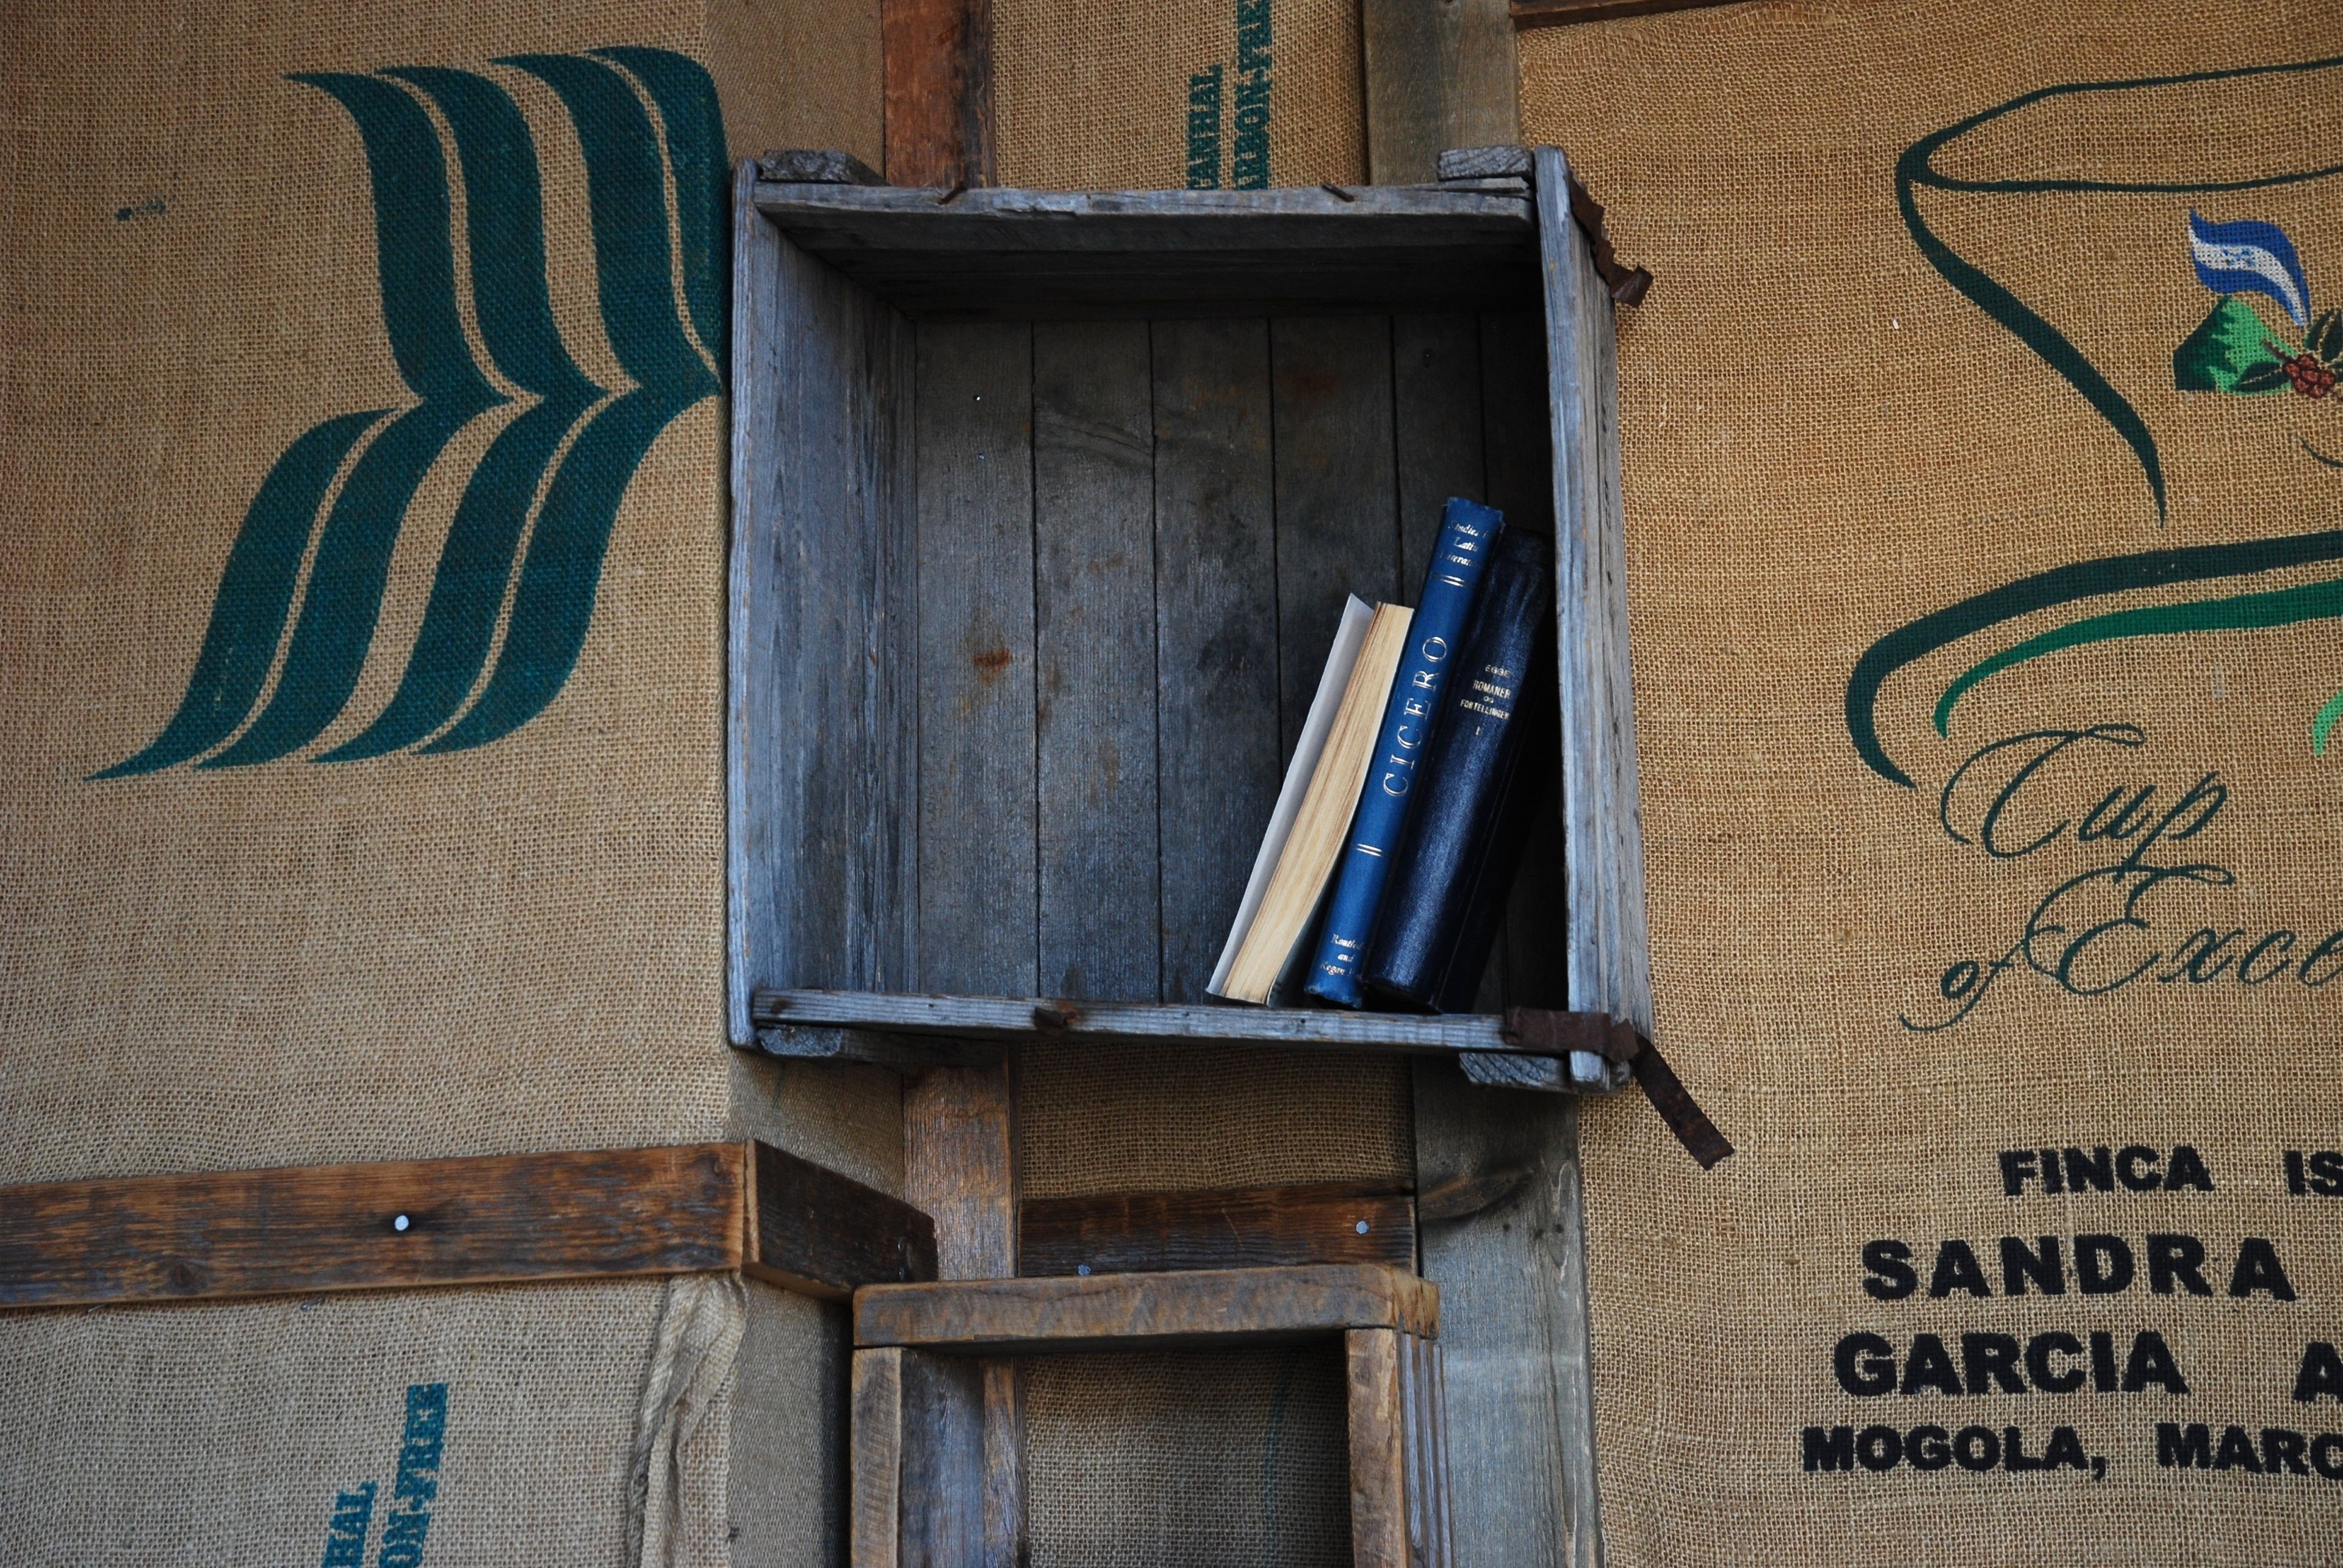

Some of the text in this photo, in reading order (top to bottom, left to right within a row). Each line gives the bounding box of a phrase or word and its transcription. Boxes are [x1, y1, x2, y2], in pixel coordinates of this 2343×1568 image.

[1454, 537, 1478, 552] Latin
[1472, 680, 1510, 699] ROMANER
[1485, 664, 1510, 678] EGGE
[1383, 636, 1447, 796] CICERO
[1460, 699, 1510, 719] FORTELLINGER
[1940, 723, 2230, 883] Cup
[1337, 954, 1355, 962] and
[1899, 922, 2065, 1032] of
[1998, 1146, 2214, 1196] FINCA
[1862, 1234, 2297, 1302] SANDRA
[1834, 1331, 2189, 1397] GARCIA
[1802, 1425, 2106, 1480] MOGOLA,
